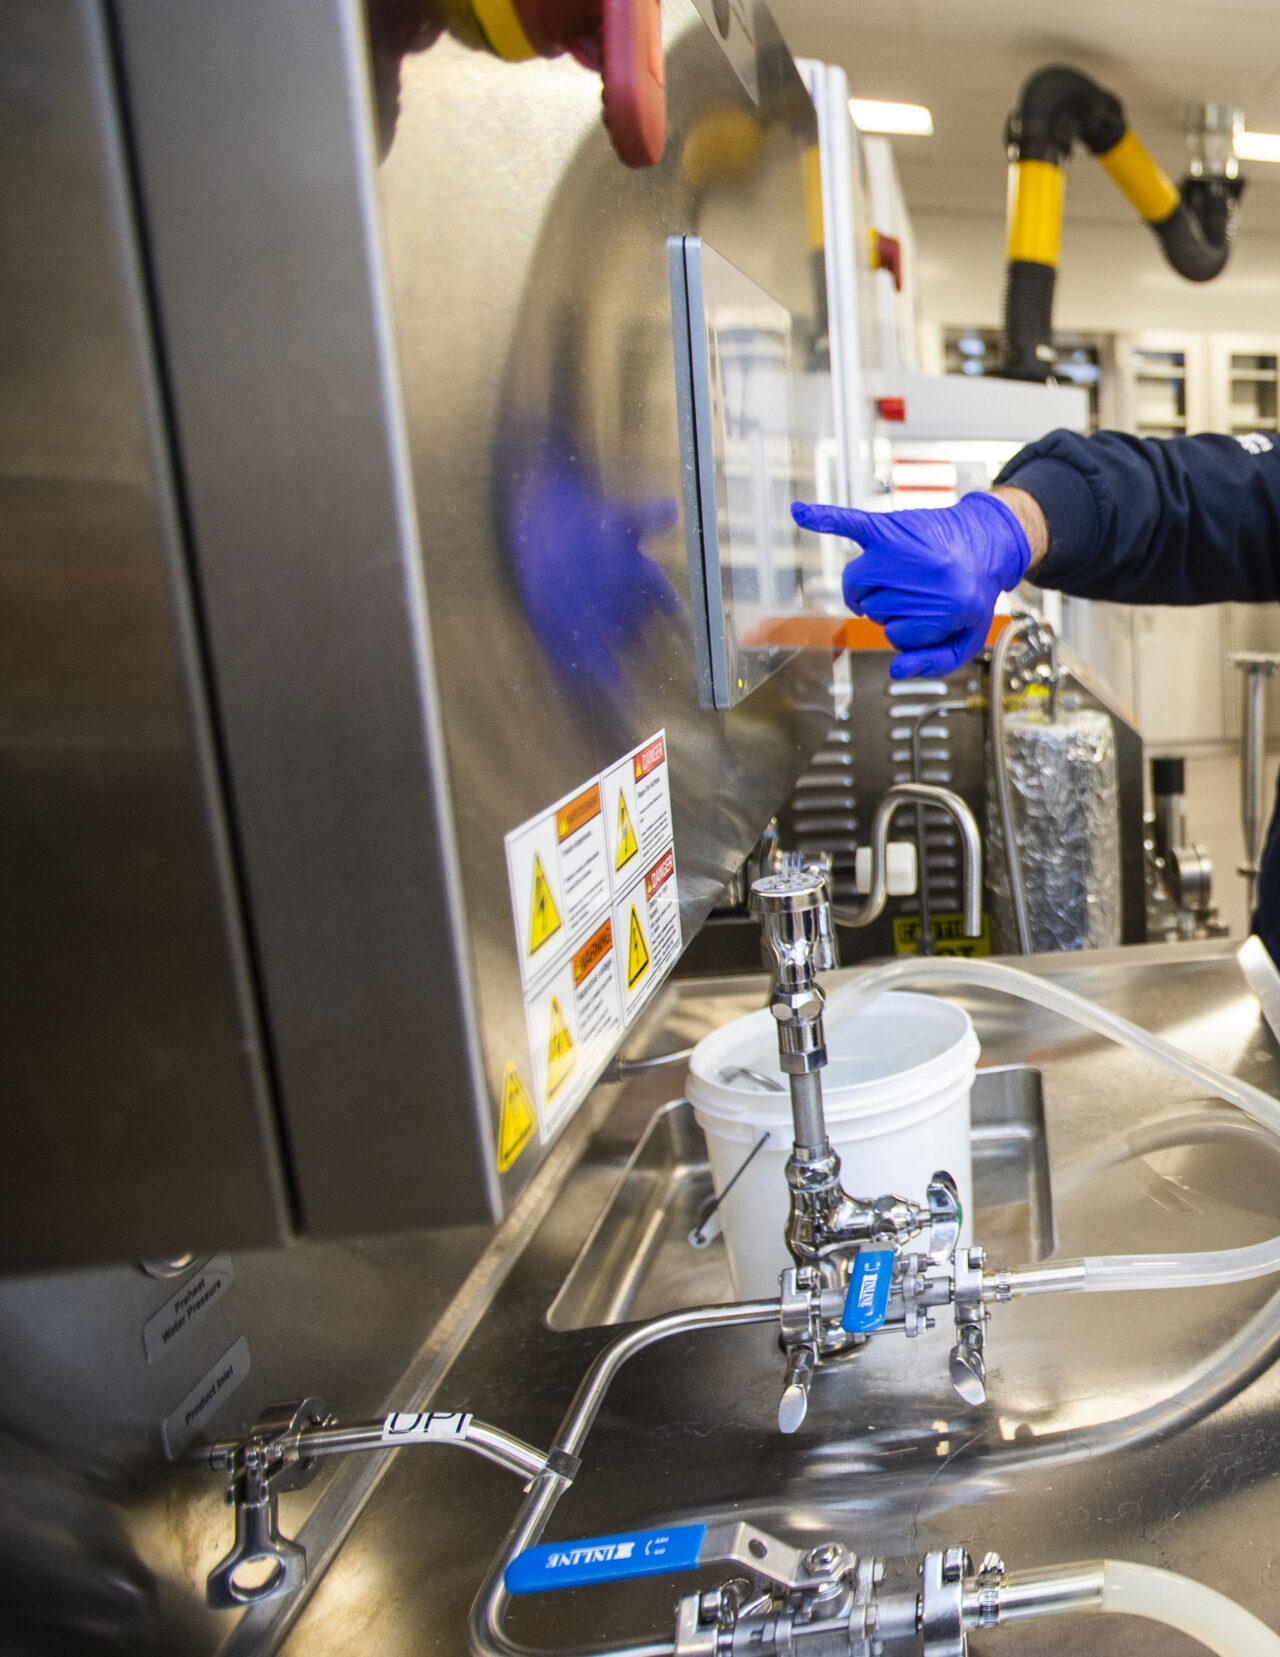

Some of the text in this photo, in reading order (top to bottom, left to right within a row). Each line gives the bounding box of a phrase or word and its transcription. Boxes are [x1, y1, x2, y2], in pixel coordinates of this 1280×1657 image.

[641, 742, 663, 770] DANGER
[651, 854, 673, 889] DANGER
[580, 927, 611, 970] WARNING
[162, 1280, 222, 1344] Water Pressure
[174, 1277, 206, 1315] Preheat
[860, 1280, 876, 1308] INLINE
[185, 1364, 234, 1426] Product Inlet
[545, 1546, 618, 1569] INLINE
